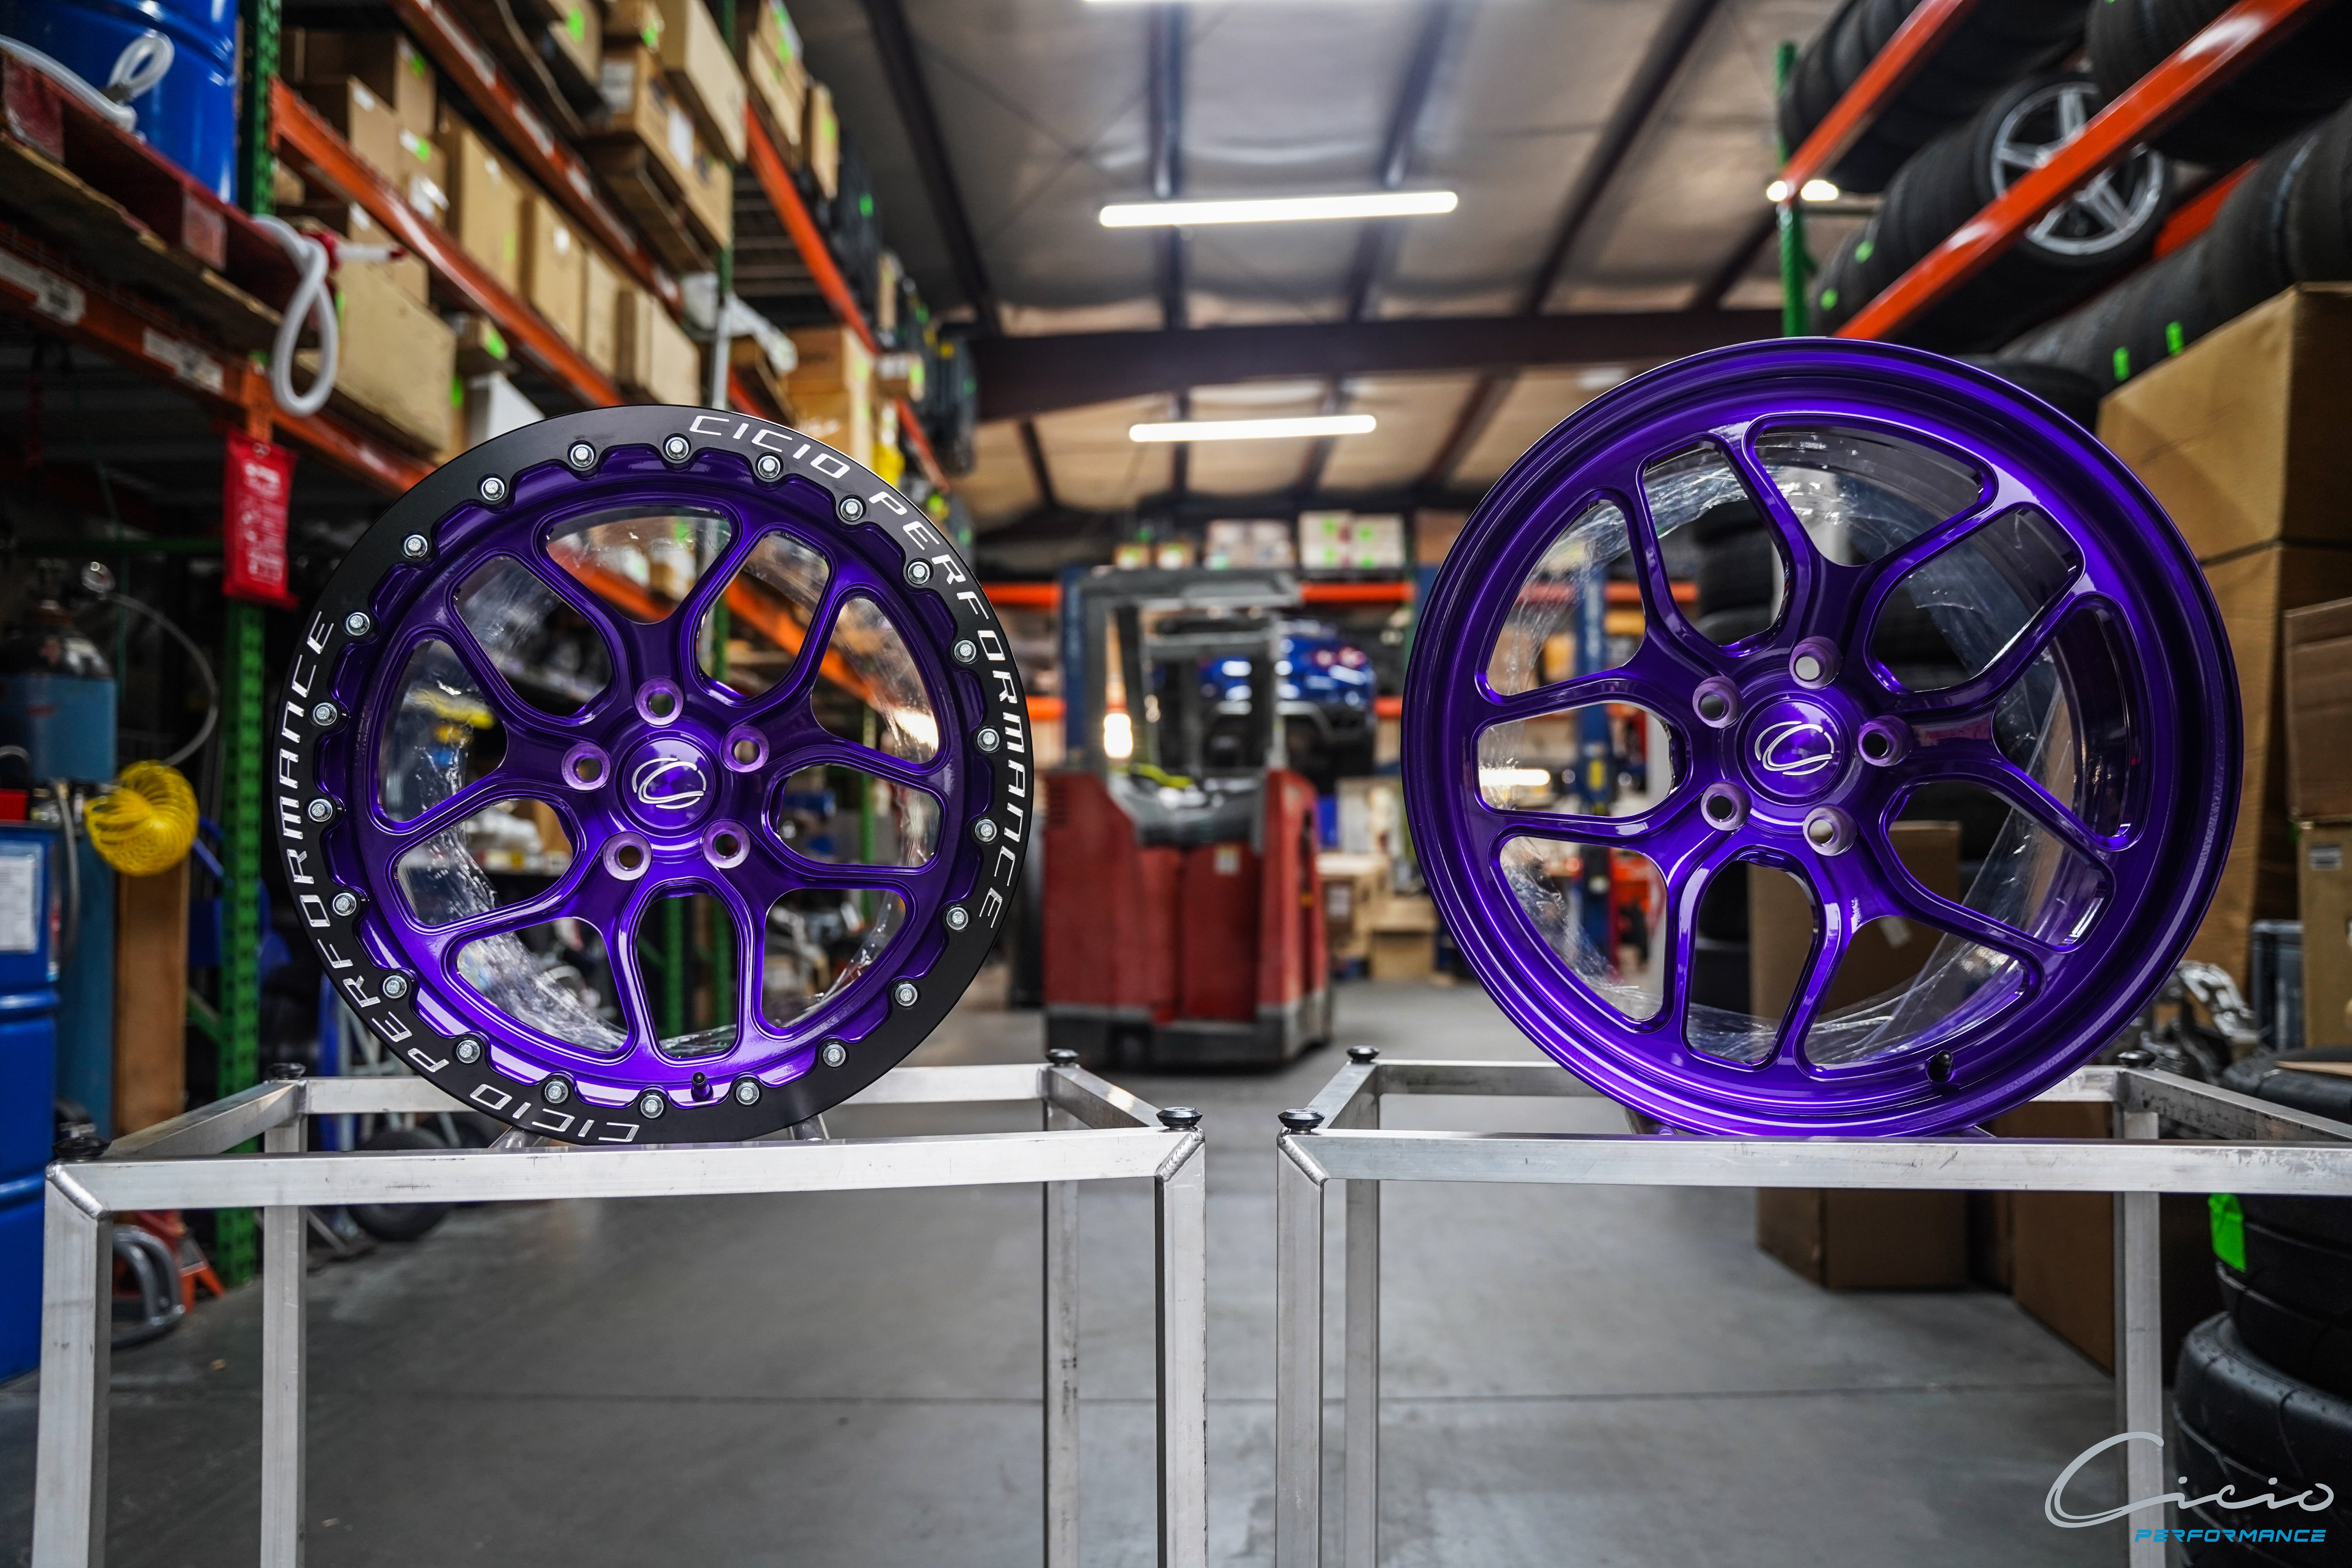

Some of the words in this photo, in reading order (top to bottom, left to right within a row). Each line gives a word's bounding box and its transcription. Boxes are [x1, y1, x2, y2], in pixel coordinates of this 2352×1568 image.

[279, 611, 448, 1072] PERFORMANCE
[471, 1084, 639, 1142] CICIO
[689, 415, 850, 479] CICIO
[869, 491, 1026, 929] PERFORMANCE
